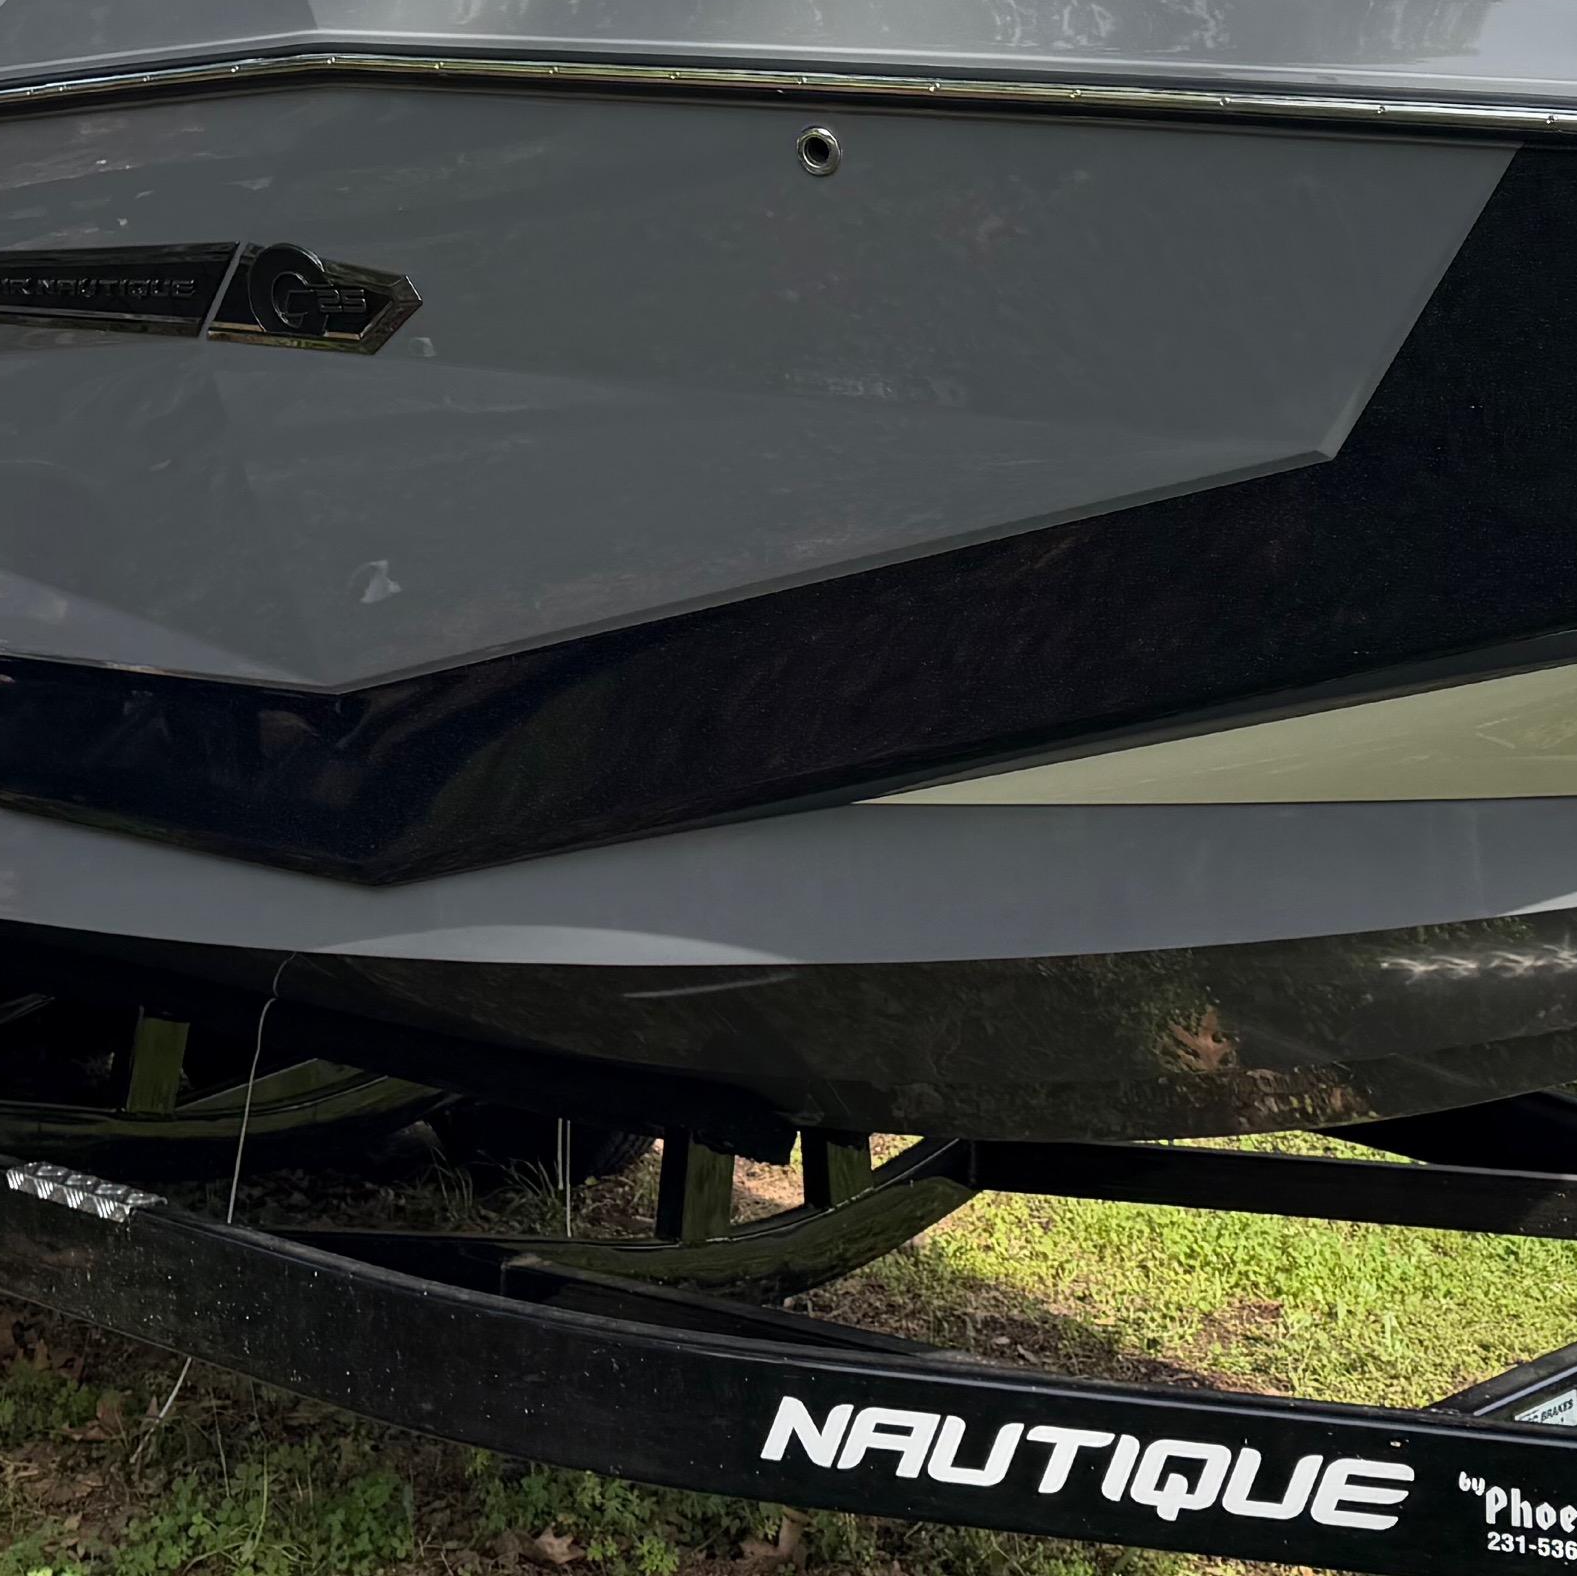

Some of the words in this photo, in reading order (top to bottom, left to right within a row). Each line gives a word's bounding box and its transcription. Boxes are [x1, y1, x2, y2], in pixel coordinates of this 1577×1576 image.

[37, 278, 196, 299] NAUTIQUE
[760, 1395, 1415, 1531] NAUTIQUE
[1458, 1471, 1486, 1496] by
